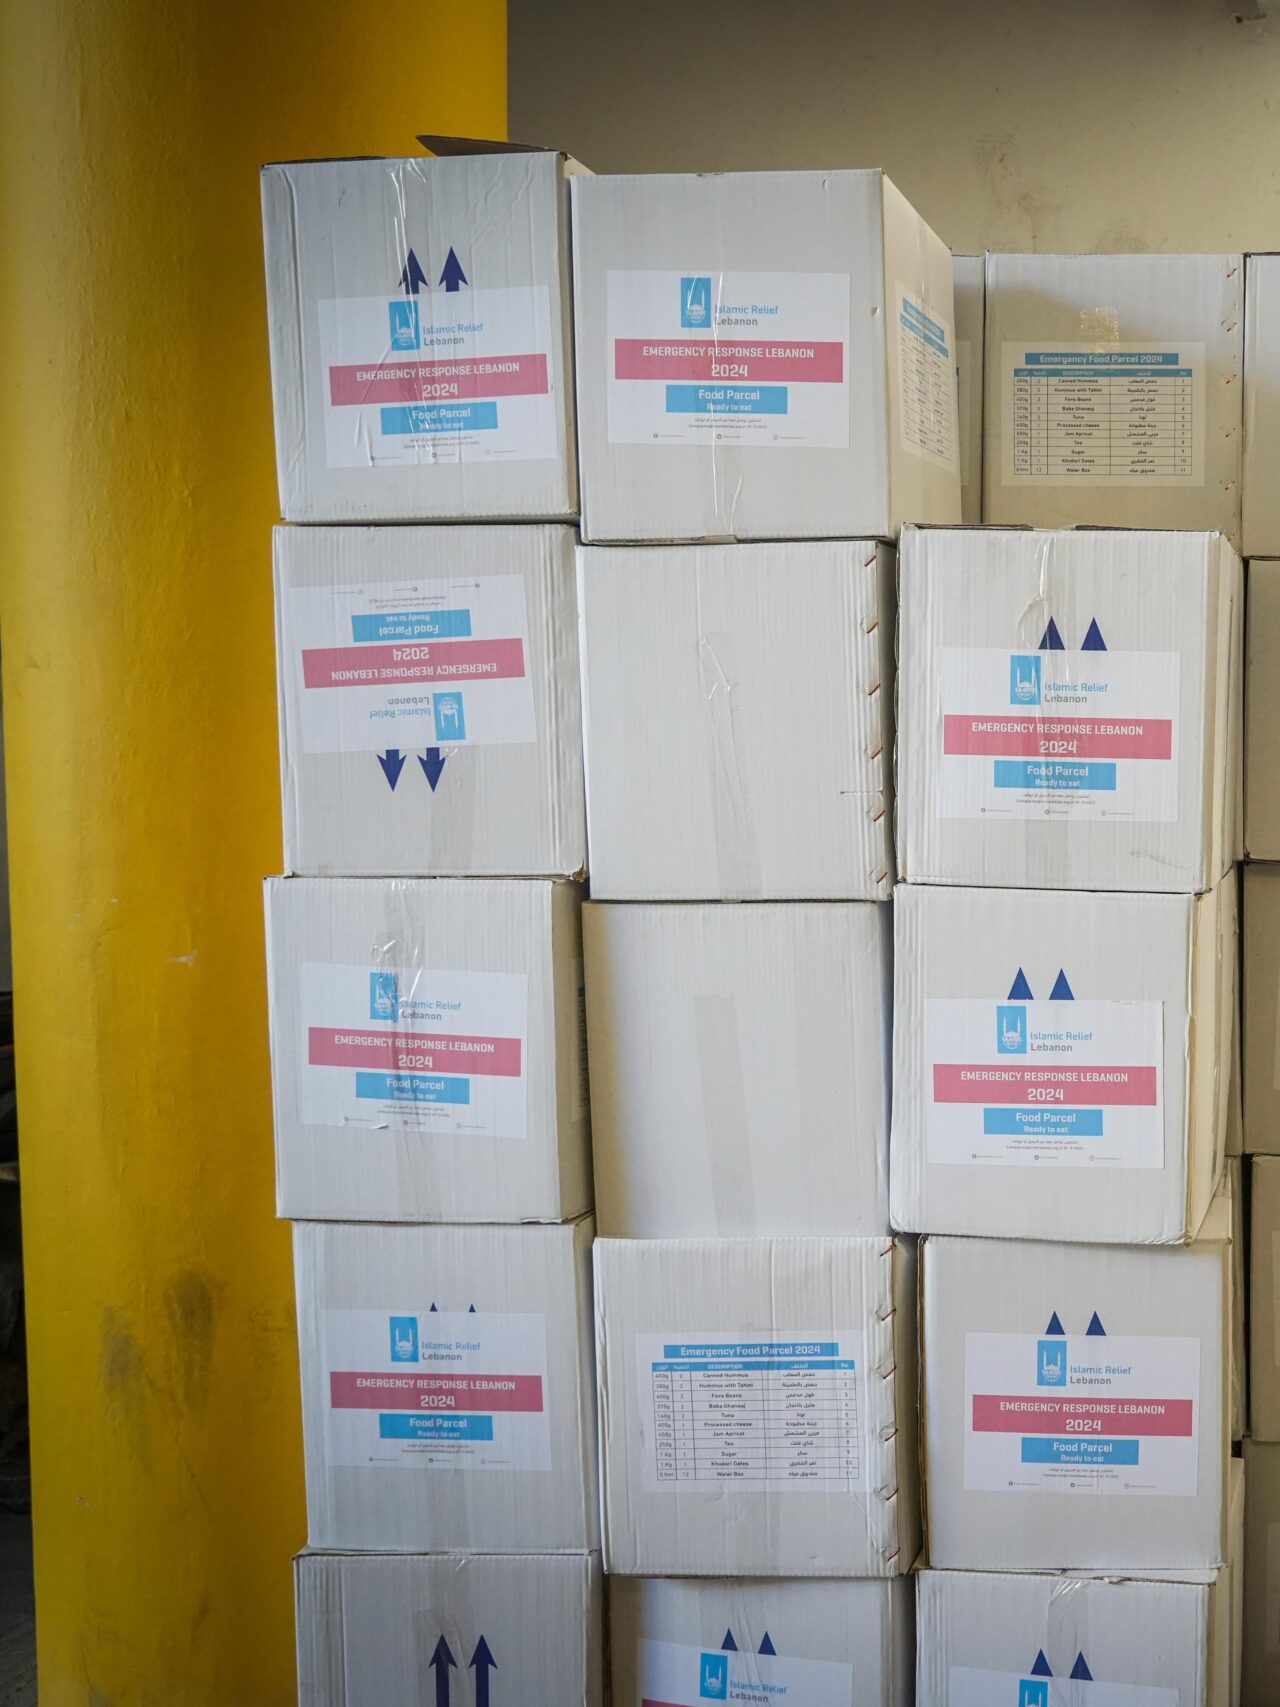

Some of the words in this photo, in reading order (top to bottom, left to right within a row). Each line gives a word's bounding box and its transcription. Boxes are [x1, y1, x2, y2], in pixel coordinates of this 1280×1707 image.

[715, 305, 748, 315] Islamic
[752, 305, 778, 315] Relief
[715, 317, 758, 326] Lebanon
[423, 324, 455, 336] Islamic
[458, 323, 483, 333] Relief
[424, 335, 464, 347] Lebanon
[643, 347, 705, 357] EMERGENCY
[708, 348, 763, 357] RESPONSE
[766, 348, 814, 358] LEBANON
[1040, 355, 1086, 364] Emergency
[357, 368, 416, 382] EMERGENCY
[419, 365, 471, 378] RESPONSE
[474, 362, 519, 375] LEBANON
[711, 365, 748, 378] 2024
[422, 382, 458, 398] 2024
[699, 391, 724, 400] Food
[727, 391, 760, 400] Parcel
[412, 410, 436, 420] Food
[439, 407, 471, 419] Parcel
[379, 625, 411, 636] Parcel
[414, 624, 439, 634] Food
[393, 646, 429, 661] 2024
[332, 668, 378, 680] LEBANON
[380, 665, 433, 678] RESPONSE
[436, 662, 497, 675] EMERGENCY
[1045, 682, 1078, 692] Islamic
[1081, 683, 1108, 692] Relief
[388, 696, 429, 706] Lebanon
[1045, 694, 1087, 703] Lebanon
[369, 709, 395, 719] Relief
[398, 706, 430, 717] Islamic
[972, 722, 1034, 733] EMERGENCY
[1037, 724, 1092, 734] RESPONSE
[1095, 725, 1143, 735] LEBANON
[1040, 741, 1077, 754] 2024
[1027, 766, 1052, 775] Food
[1056, 767, 1089, 776] Parcel
[436, 1001, 461, 1011] Relief
[402, 1011, 442, 1021] Lebanon
[1031, 1032, 1063, 1041] Islamic
[1066, 1032, 1092, 1041] Relief
[335, 1035, 392, 1047] EMERGENCY
[396, 1039, 447, 1050] RESPONSE
[449, 1042, 494, 1053] LEBANON
[1031, 1043, 1072, 1052] Lebanon
[398, 1055, 433, 1068] 2024
[961, 1071, 1021, 1081] EMERGENCY
[1025, 1072, 1078, 1081] RESPONSE
[1081, 1073, 1128, 1082] LEBANON
[387, 1078, 410, 1088] Food
[413, 1080, 444, 1090] Parcel
[1028, 1088, 1064, 1101] 2024
[1016, 1113, 1040, 1122] Food
[1044, 1113, 1076, 1122] Parcel
[422, 1342, 453, 1350] Islamic
[456, 1342, 481, 1350] Relief
[681, 1347, 734, 1357] Emergency
[737, 1347, 760, 1355] Food
[763, 1347, 793, 1355] Parcel
[796, 1346, 821, 1354] 2024
[423, 1352, 462, 1361] Lebanon
[1070, 1365, 1102, 1374] Islamic
[1105, 1366, 1131, 1374] Relief
[357, 1379, 414, 1388] EMERGENCY
[417, 1380, 468, 1389] RESPONSE
[471, 1381, 515, 1390] LEBANON
[1070, 1376, 1111, 1384] Lebanon
[421, 1395, 455, 1407] 2024
[1000, 1402, 1060, 1412] EMERGENCY
[1063, 1403, 1116, 1413] RESPONSE
[1119, 1405, 1164, 1414] LEBANON
[410, 1419, 434, 1427] Food
[437, 1419, 467, 1428] Parcel
[1065, 1419, 1101, 1431] 2024
[1054, 1442, 1078, 1451] Food
[1081, 1443, 1113, 1452] Parcel
[730, 1682, 760, 1691] Islamic
[762, 1684, 787, 1694] Relief
[730, 1690, 768, 1702] Lebanon
